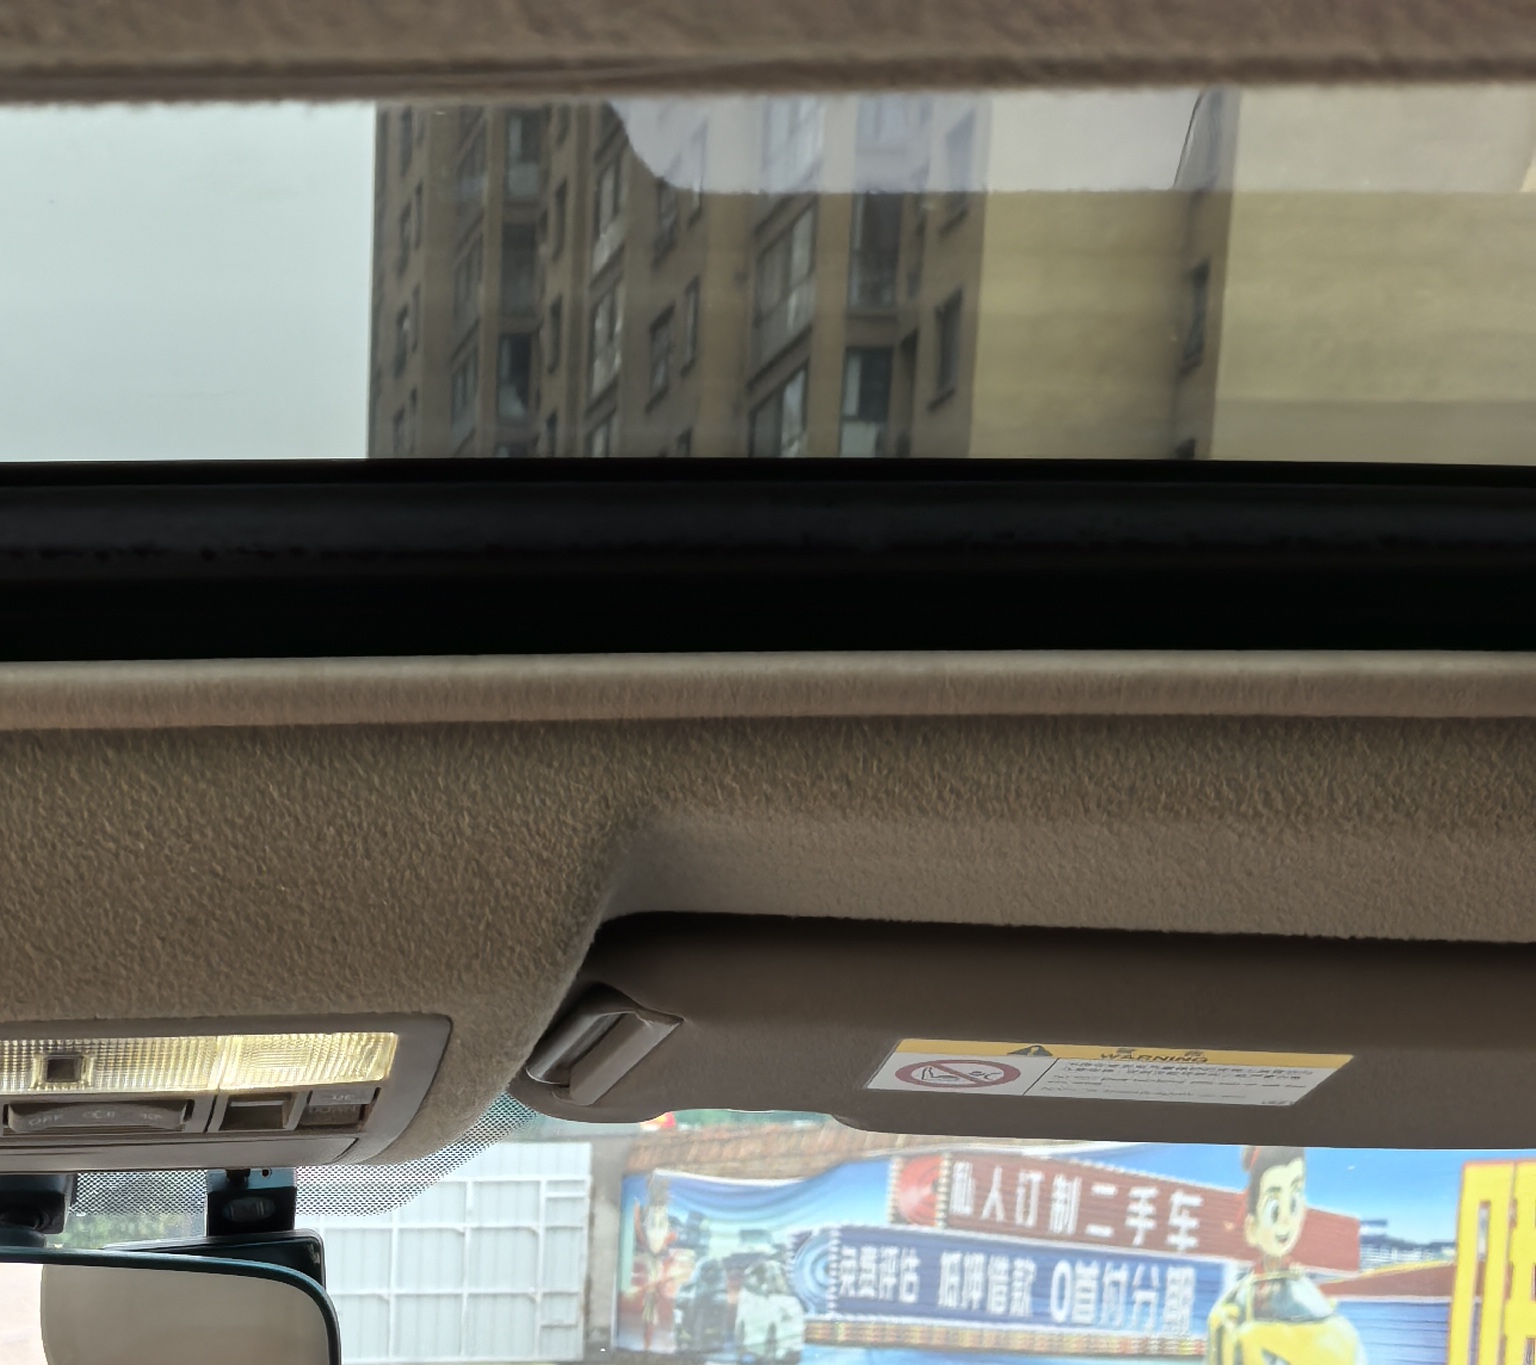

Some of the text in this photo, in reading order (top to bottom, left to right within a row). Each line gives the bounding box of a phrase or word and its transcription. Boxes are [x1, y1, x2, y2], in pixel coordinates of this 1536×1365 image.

[949, 1161, 1205, 1253] 私人订制二手车
